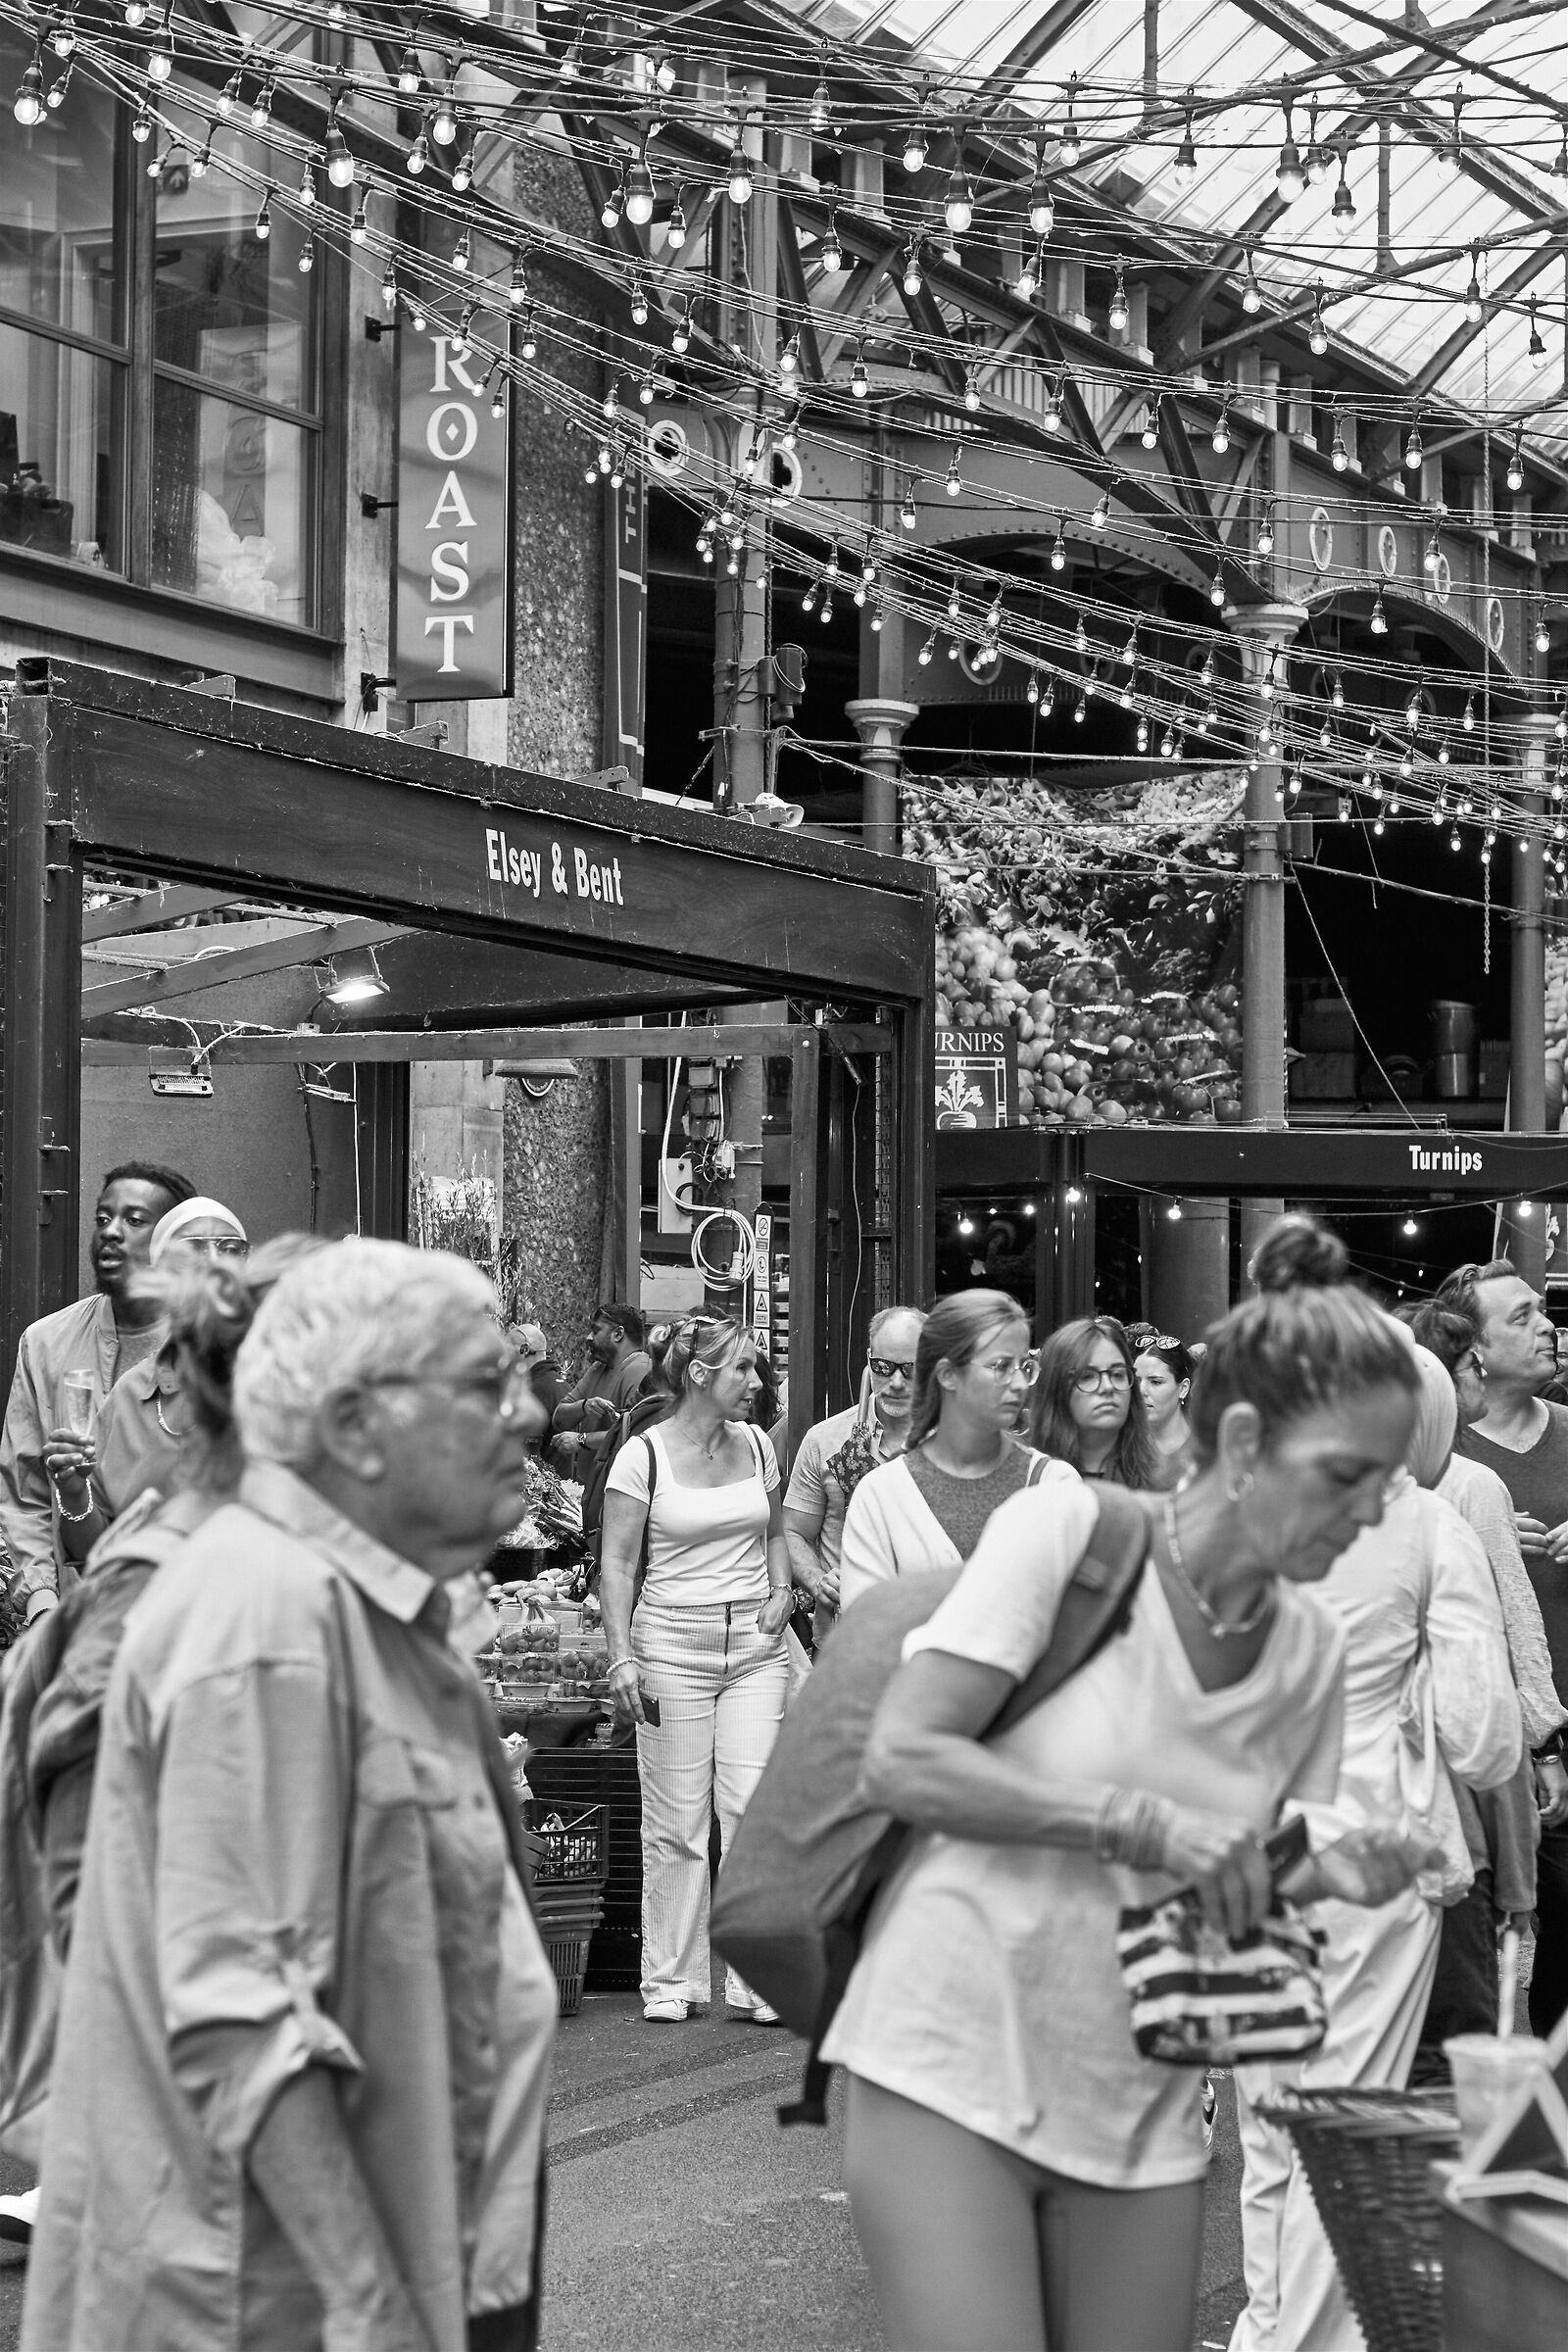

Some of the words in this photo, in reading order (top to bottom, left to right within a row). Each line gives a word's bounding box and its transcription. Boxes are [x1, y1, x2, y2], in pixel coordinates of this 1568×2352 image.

[424, 335, 477, 672] ROAST
[486, 829, 540, 898] Elsey
[552, 842, 567, 894] &
[574, 848, 623, 906] Bent
[1409, 1146, 1482, 1175] Turnips
